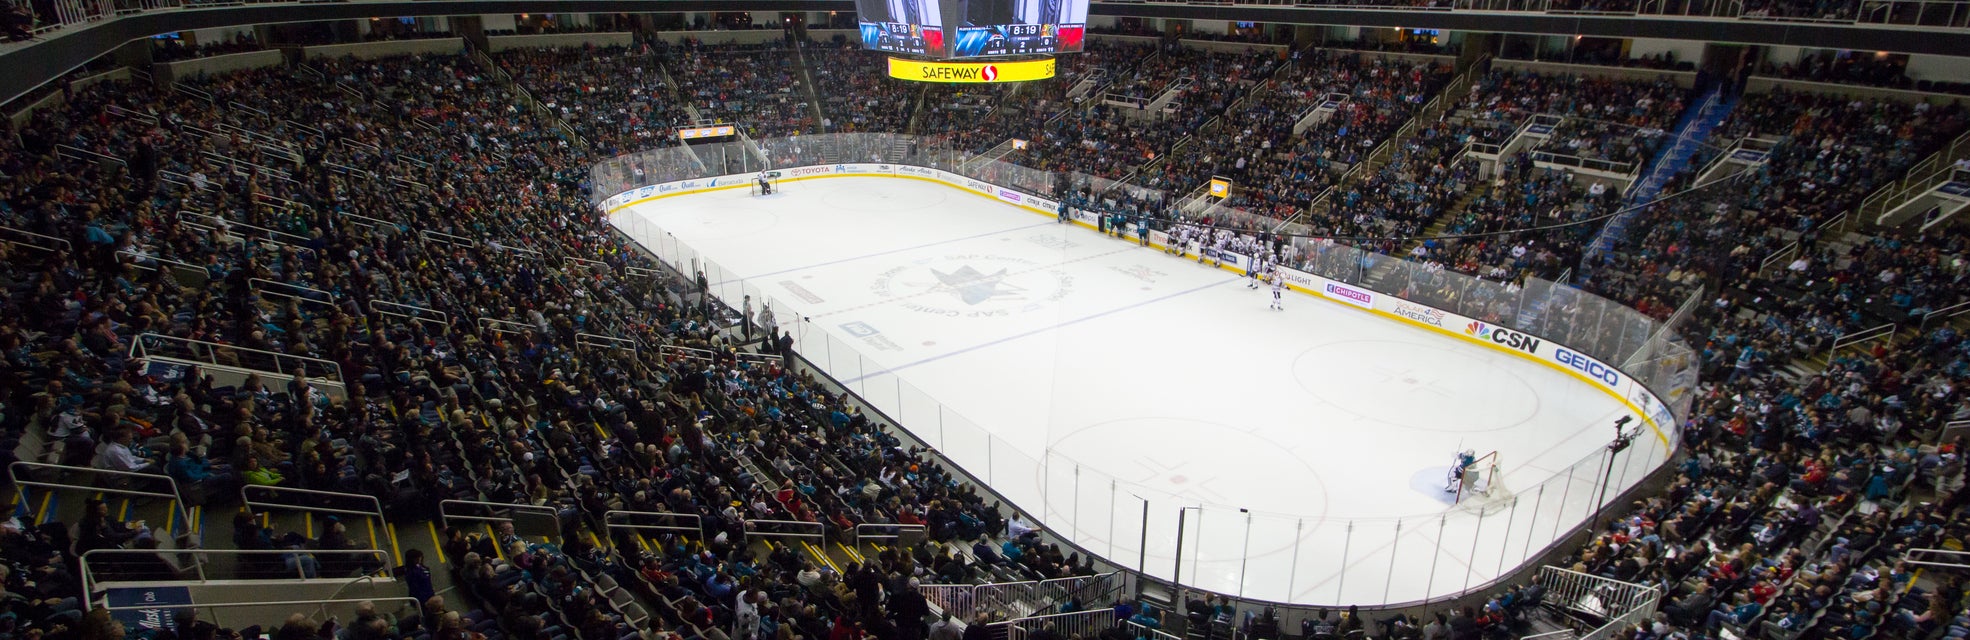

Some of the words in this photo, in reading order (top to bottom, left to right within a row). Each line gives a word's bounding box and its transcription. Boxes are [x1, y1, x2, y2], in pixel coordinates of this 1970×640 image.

[891, 25, 908, 34] 8:19
[1013, 26, 1036, 35] 8:19
[922, 66, 979, 79] SAFEWAY
[802, 167, 830, 175] TOYOTA
[967, 180, 986, 191] SAFEWAY
[1291, 274, 1312, 285] LIGHT
[1335, 287, 1370, 302] CHIPOTLE
[1393, 306, 1442, 327] AMERICA
[1492, 328, 1540, 354] CSN
[1555, 348, 1619, 387] GEICO
